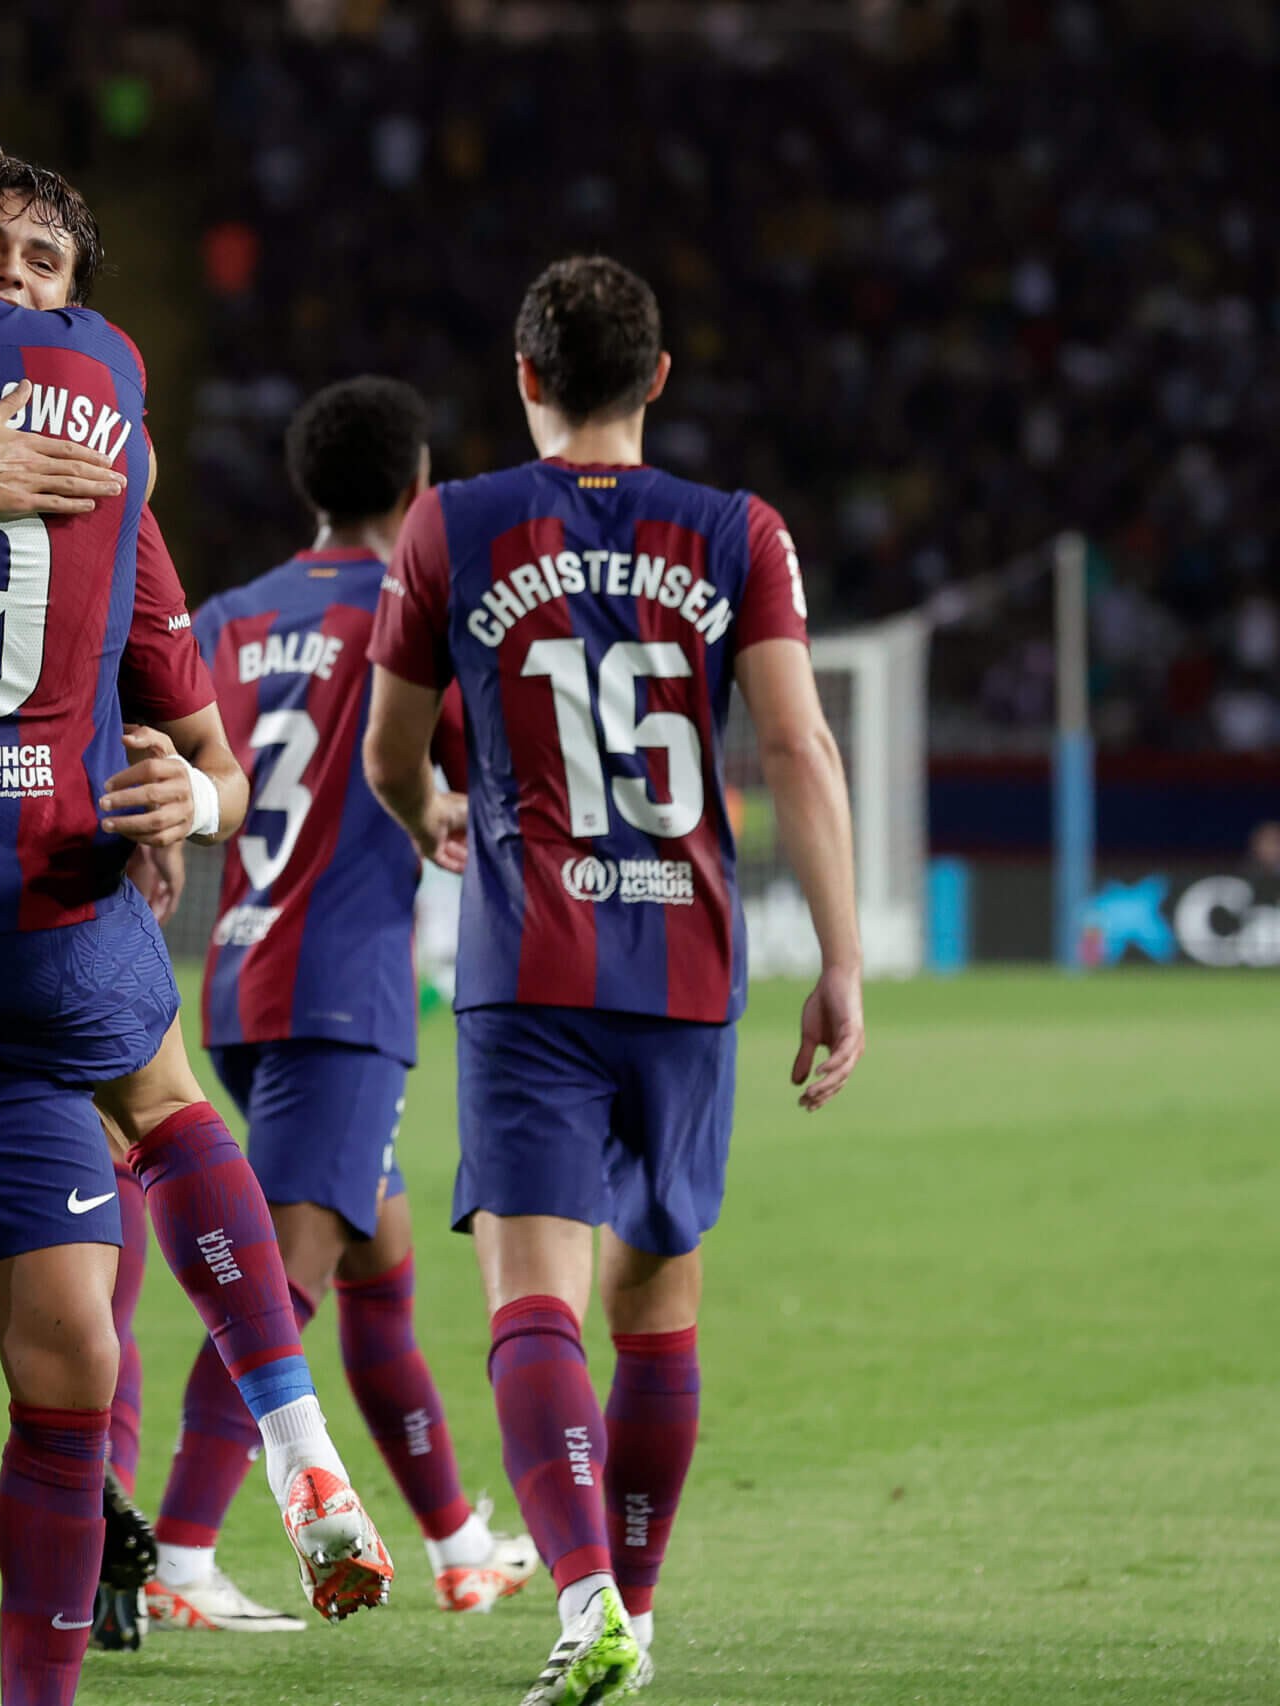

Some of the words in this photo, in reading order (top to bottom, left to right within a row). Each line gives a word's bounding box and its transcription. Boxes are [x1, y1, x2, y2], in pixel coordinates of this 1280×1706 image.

[467, 550, 734, 648] CHRISTENSEN
[238, 632, 343, 684] BALDE
[520, 637, 704, 839] 15
[27, 788, 54, 797] Agency
[237, 708, 319, 891] 3
[196, 1228, 243, 1285] BARÇA
[564, 1426, 594, 1486] BARÇA
[625, 1494, 654, 1546] BARÇA
